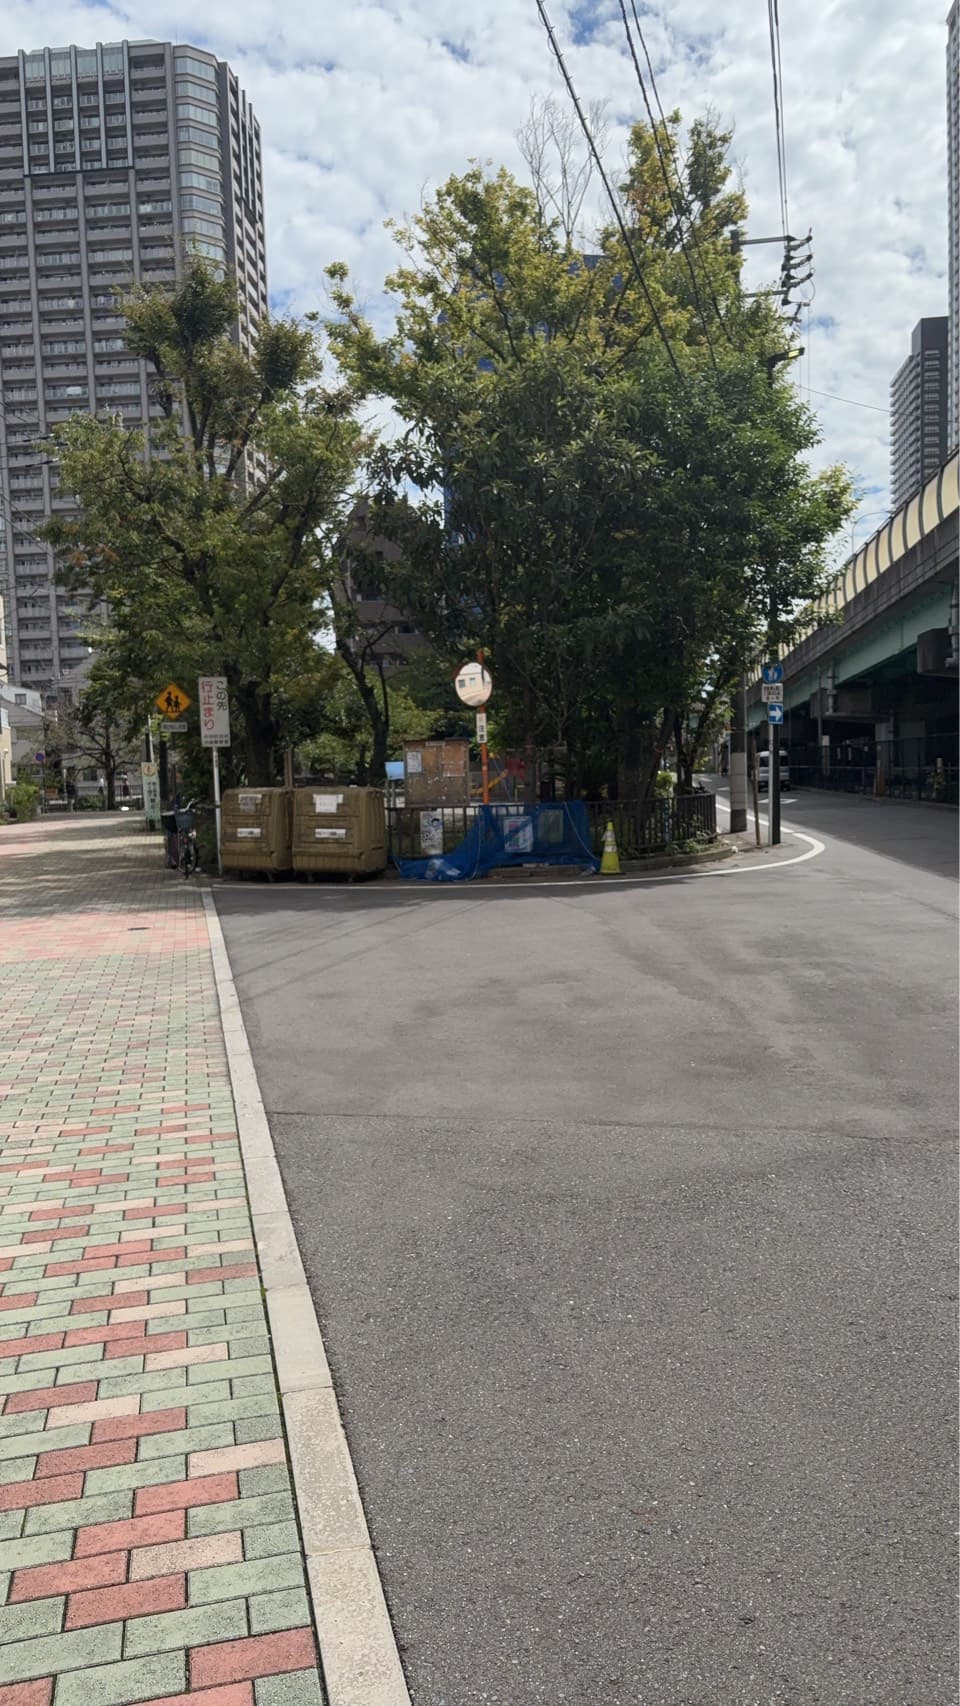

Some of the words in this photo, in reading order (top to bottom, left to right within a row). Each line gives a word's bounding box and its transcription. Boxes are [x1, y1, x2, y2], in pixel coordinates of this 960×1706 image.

[201, 680, 215, 730] 行止まり
[216, 680, 228, 711] この先
